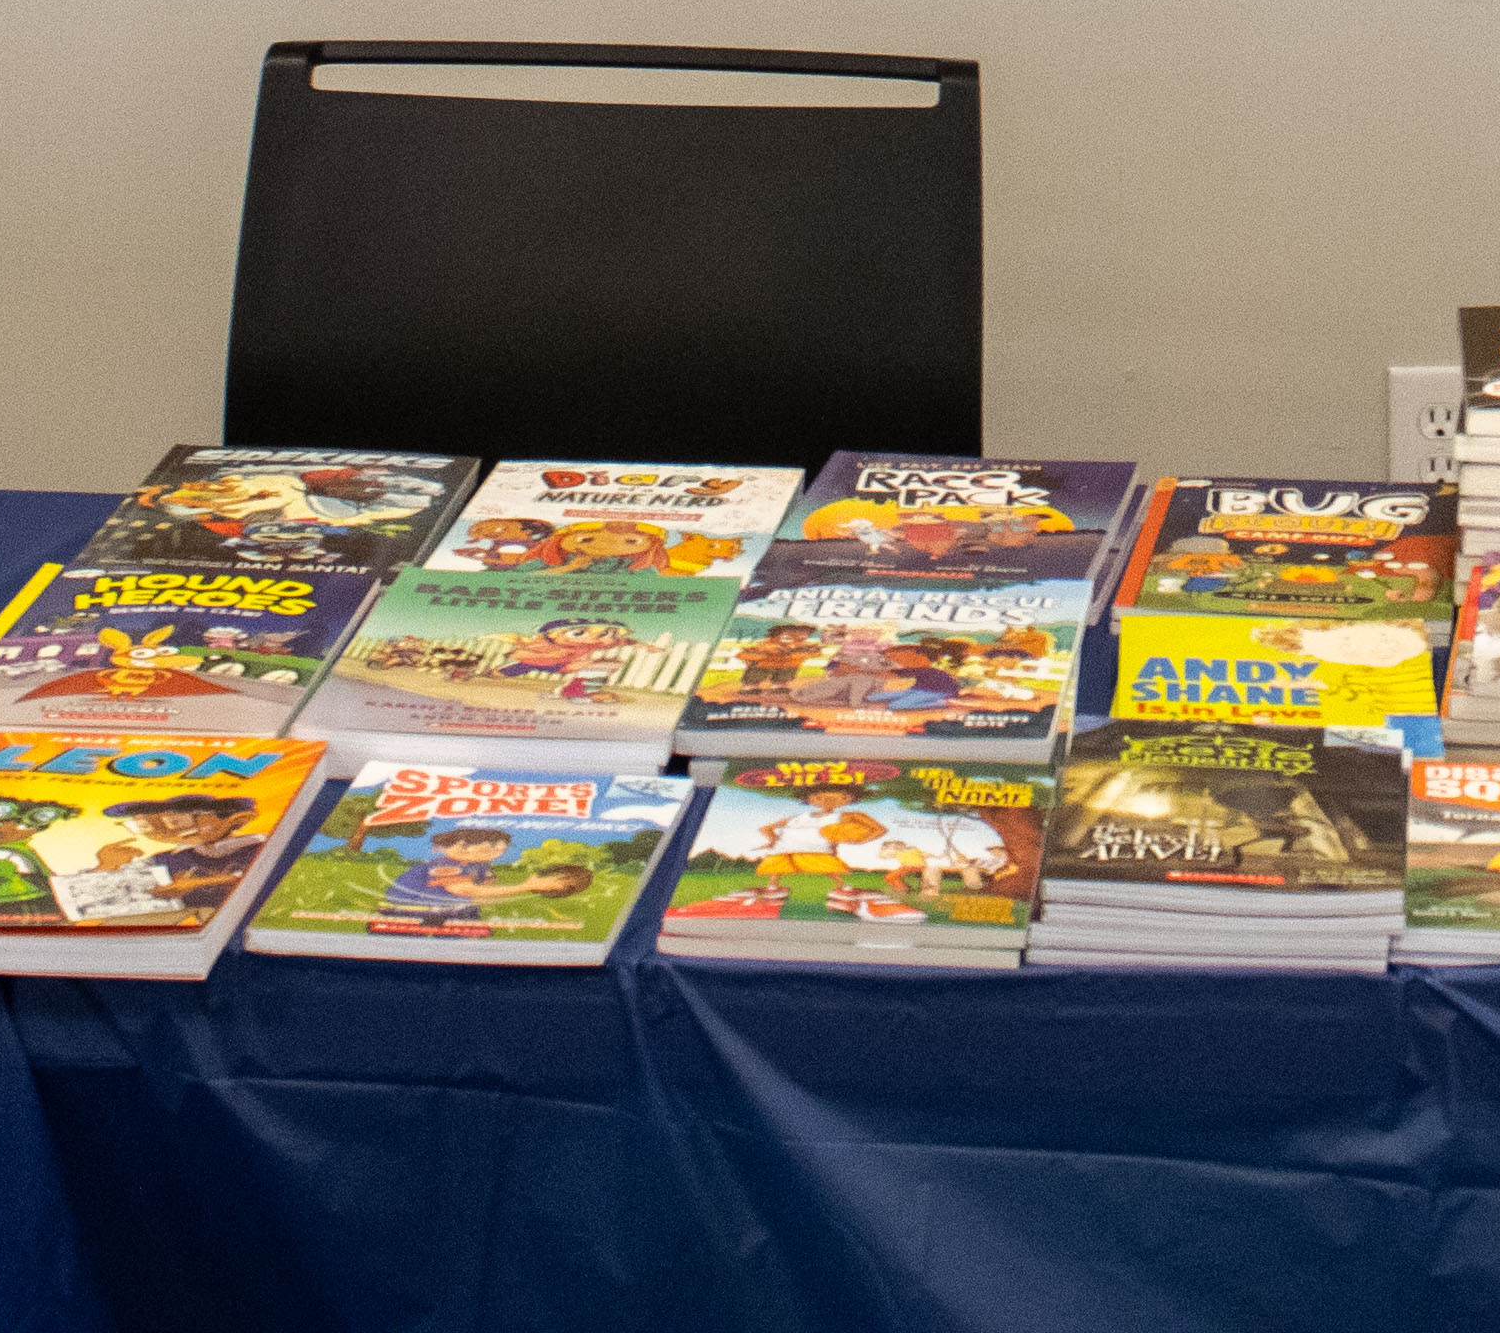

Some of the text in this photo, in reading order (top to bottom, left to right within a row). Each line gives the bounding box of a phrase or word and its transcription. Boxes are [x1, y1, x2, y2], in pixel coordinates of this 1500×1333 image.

[183, 449, 455, 469] SIDEKICKS
[536, 491, 725, 509] NATURE NERD
[900, 487, 1050, 509] PACK
[1207, 488, 1429, 525] BUG
[95, 574, 314, 597] HOUND
[416, 582, 708, 603] BABY-SITTERS
[767, 589, 902, 602] ANIMAL
[75, 589, 317, 616] HEROES
[430, 596, 678, 613] LITTLE SISTER
[787, 599, 1036, 625] FRIENDS
[1137, 656, 1321, 684] ANDY
[1130, 681, 1321, 706] SHANE
[1137, 703, 1322, 720] Is in Love
[388, 770, 596, 799] SPORTS
[365, 793, 589, 827] ZONE!
